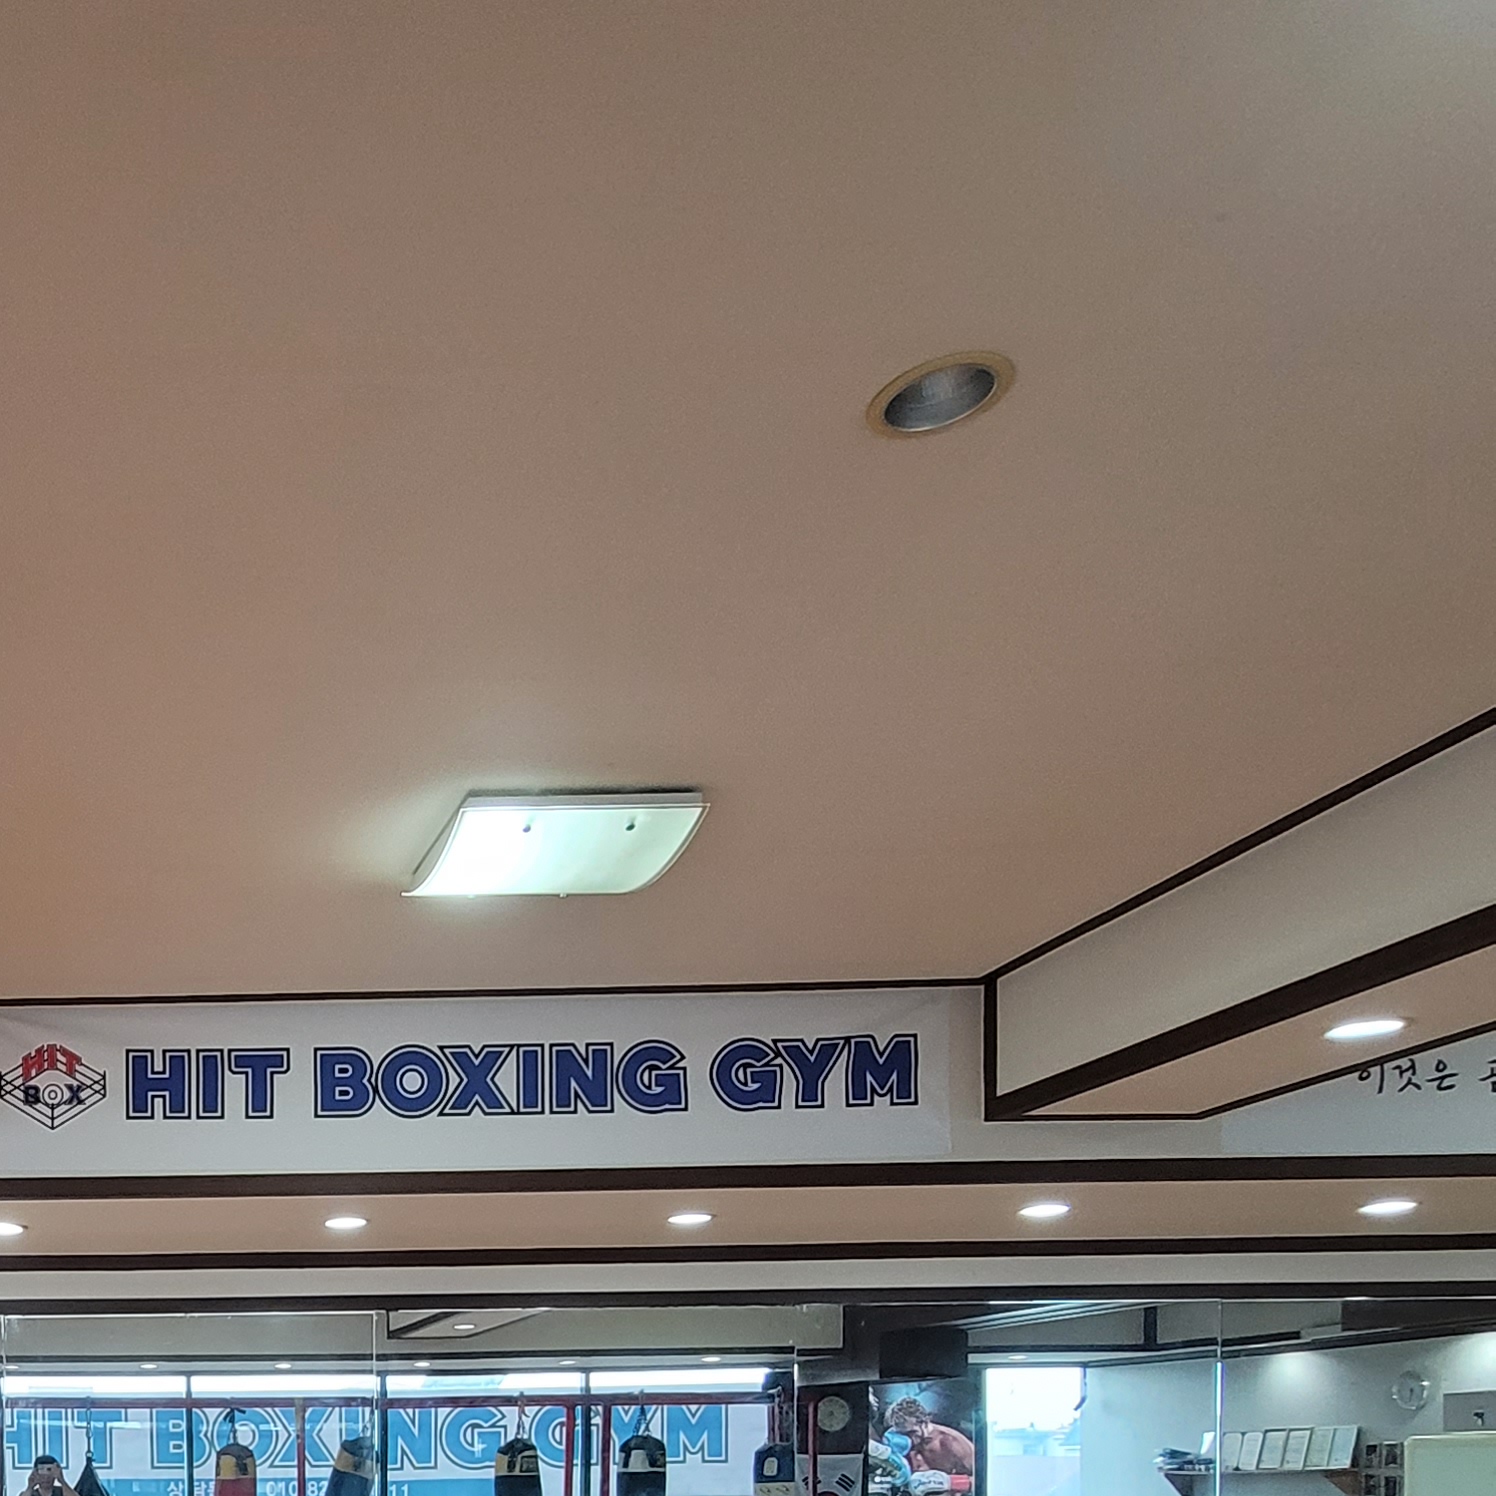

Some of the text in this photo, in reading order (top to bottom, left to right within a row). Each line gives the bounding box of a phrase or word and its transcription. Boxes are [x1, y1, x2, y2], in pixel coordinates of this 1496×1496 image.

[22, 1043, 82, 1082] HIT
[125, 1033, 919, 1119] HIT BOXING GYM
[1357, 1057, 1459, 1094] 이것은
[23, 1084, 86, 1107] BOX
